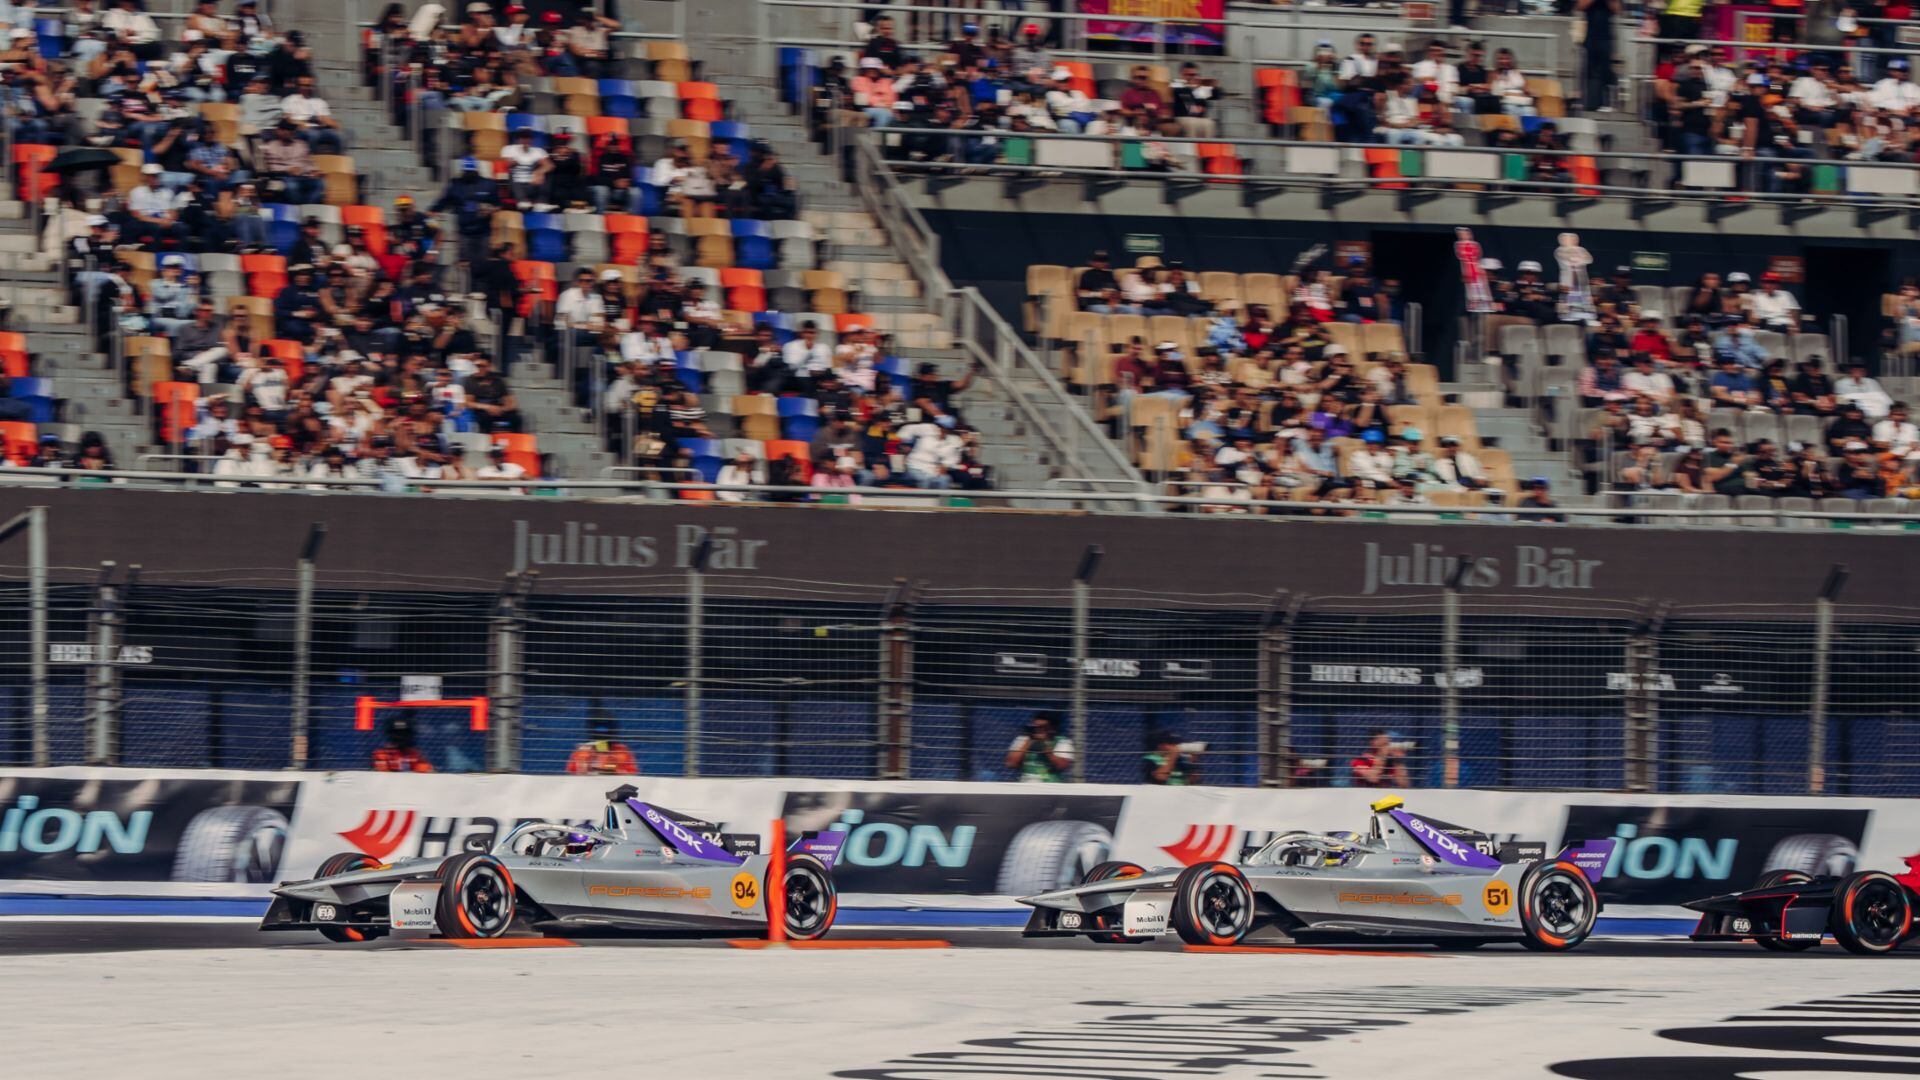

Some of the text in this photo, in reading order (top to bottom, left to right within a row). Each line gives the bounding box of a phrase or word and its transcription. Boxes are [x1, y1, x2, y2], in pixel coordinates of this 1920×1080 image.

[513, 519, 658, 574] Julius
[1362, 542, 1603, 595] Julius Bär
[659, 815, 704, 854] TDK
[1424, 824, 1469, 862] TDK
[1475, 841, 1493, 856] 51
[589, 885, 712, 899] PORSCHE
[734, 881, 756, 899] 94
[1338, 893, 1463, 905] PORSCHE
[1487, 888, 1509, 906] 51
